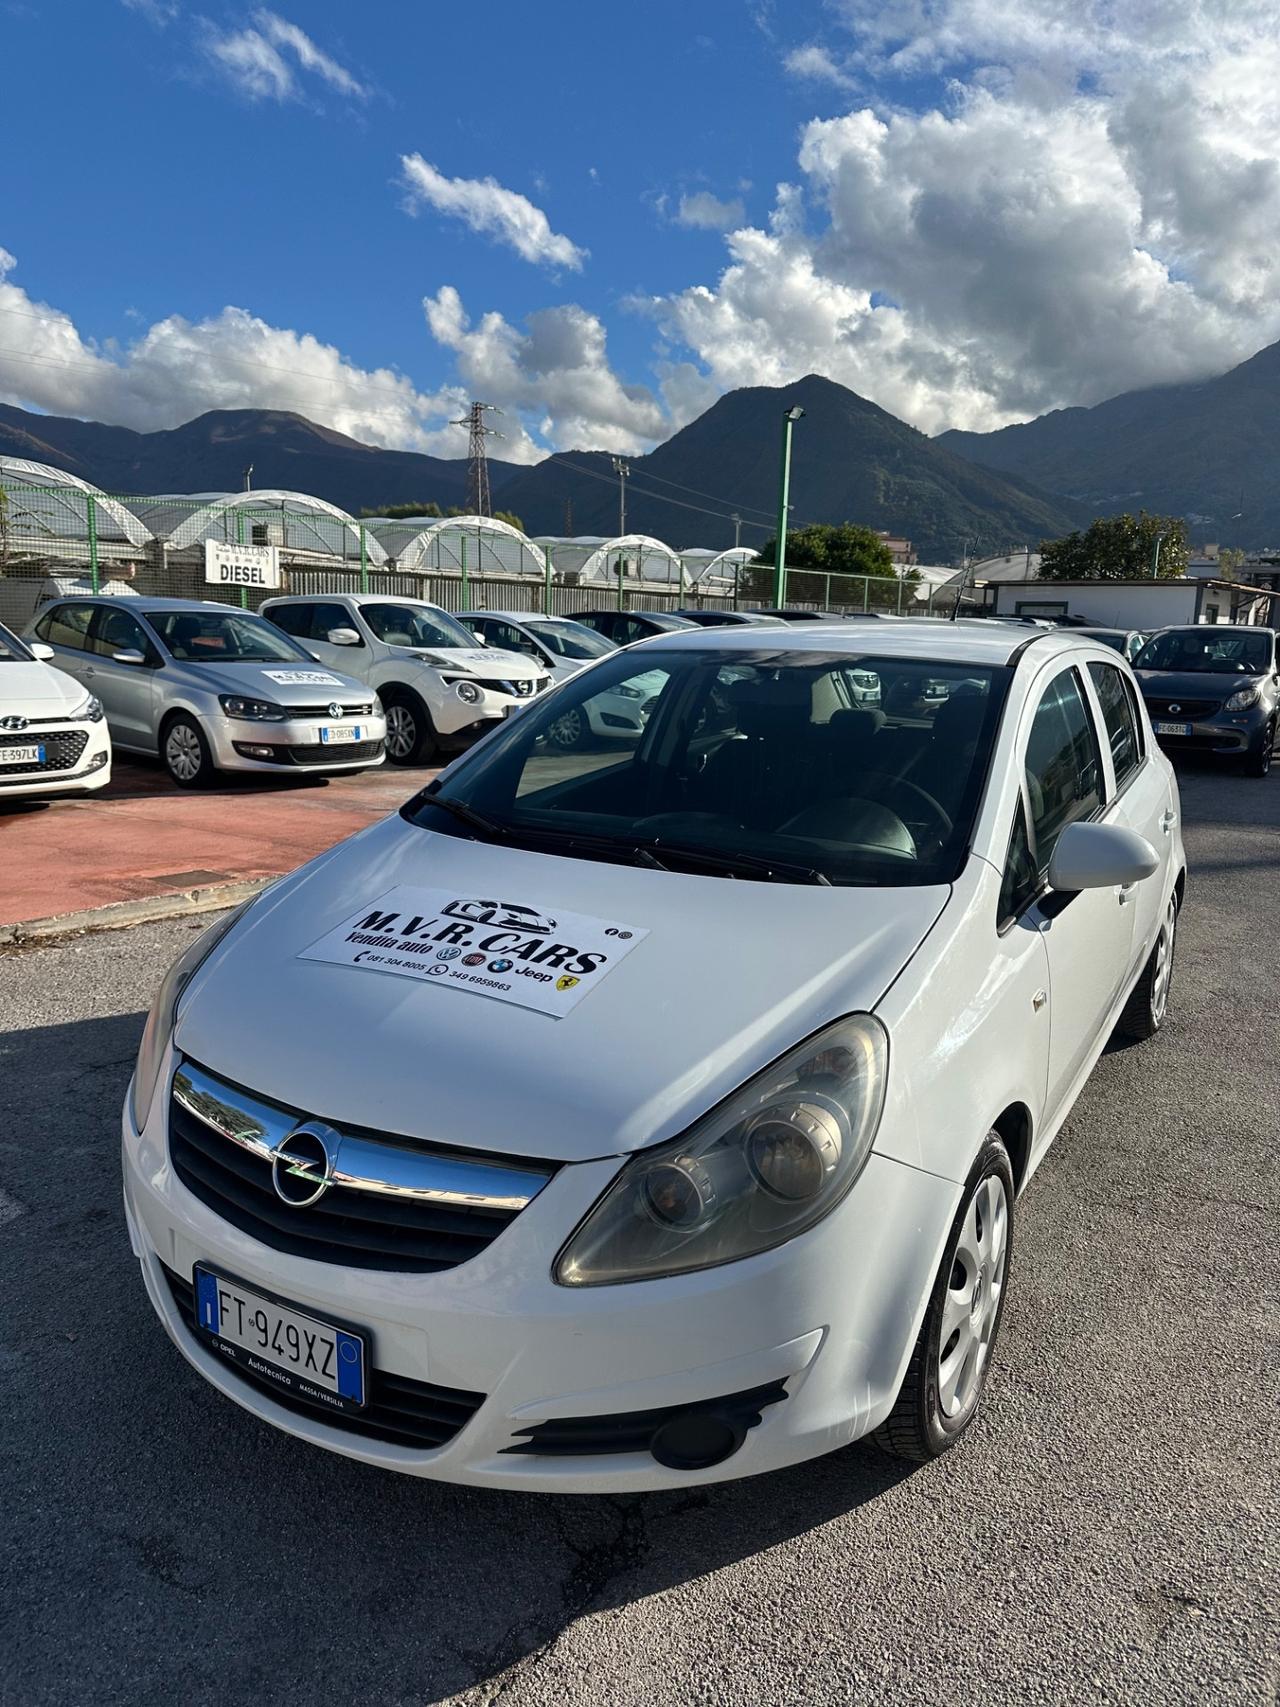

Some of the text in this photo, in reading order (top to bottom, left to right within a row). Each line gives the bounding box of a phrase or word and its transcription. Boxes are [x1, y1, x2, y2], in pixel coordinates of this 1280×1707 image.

[220, 564, 266, 584] DIESEL
[345, 931, 433, 955] Vendita auto
[366, 955, 427, 971] 081 304 8005
[449, 970, 512, 992] 349 6959863
[515, 967, 554, 983] Jeep
[219, 1343, 237, 1358] OPEL
[247, 1357, 292, 1386] Autotecnica
